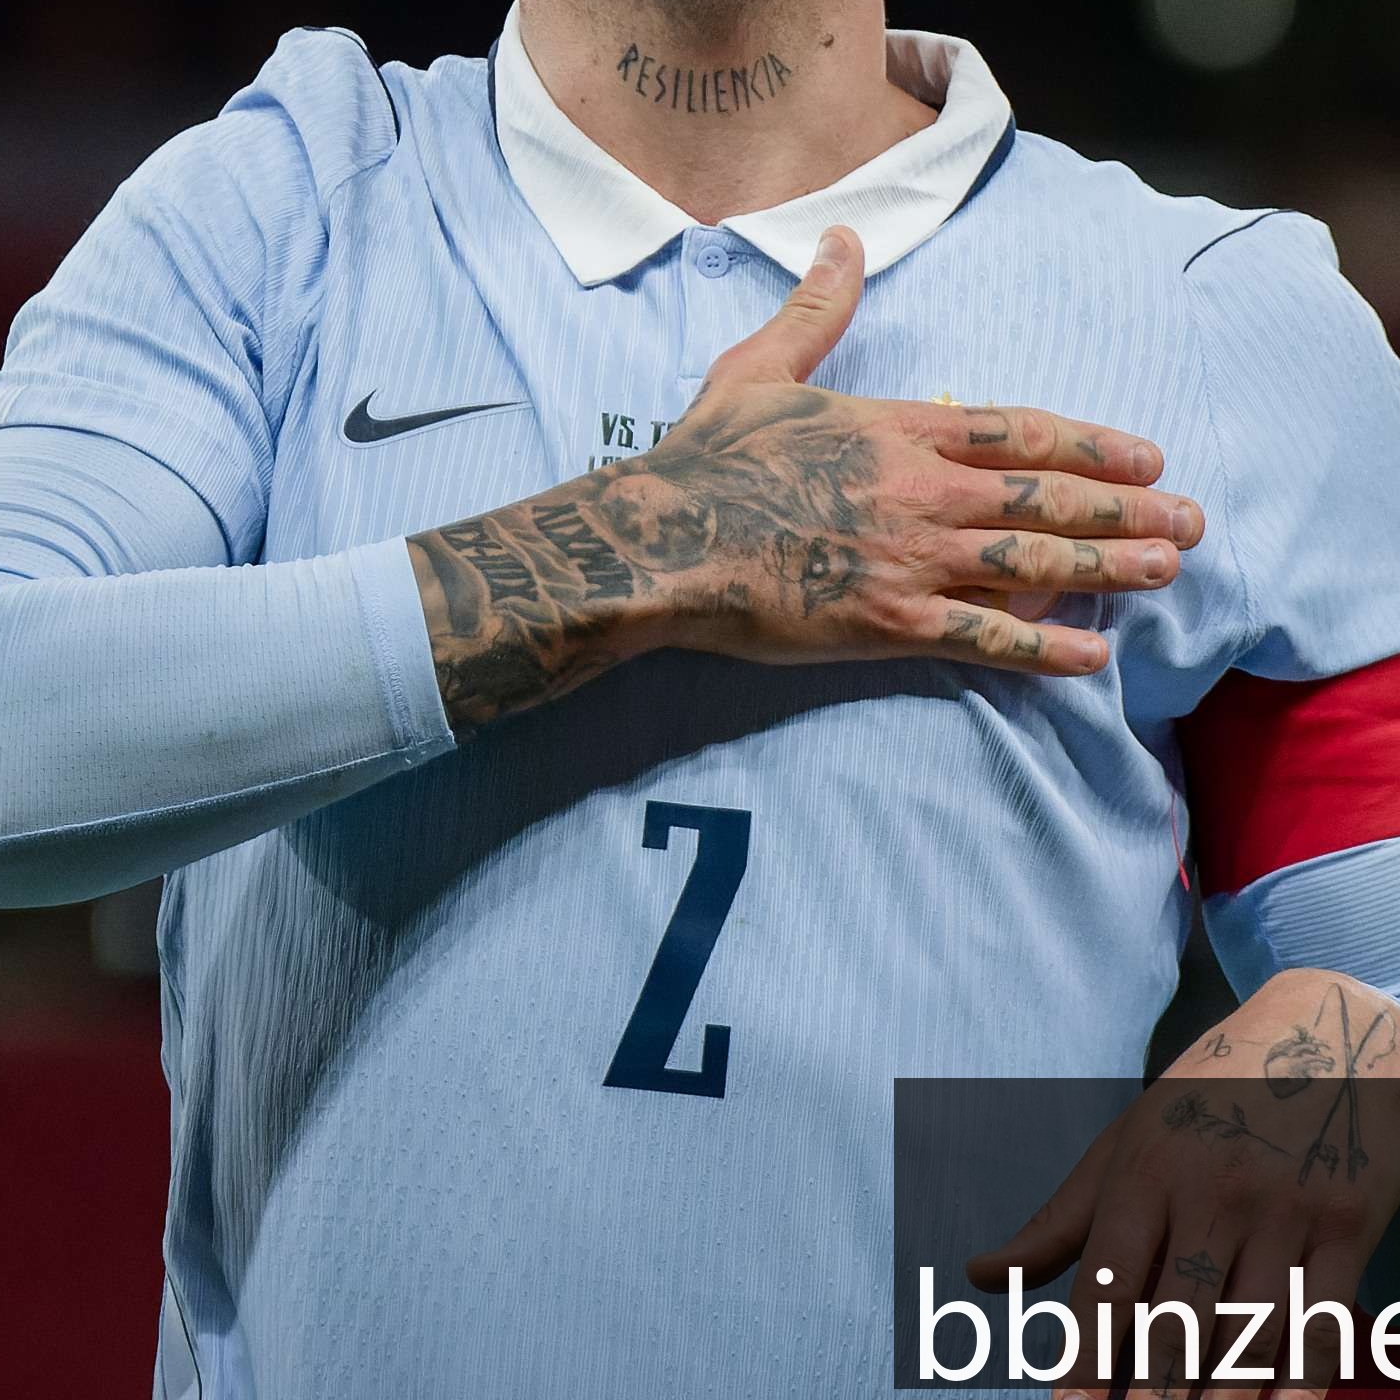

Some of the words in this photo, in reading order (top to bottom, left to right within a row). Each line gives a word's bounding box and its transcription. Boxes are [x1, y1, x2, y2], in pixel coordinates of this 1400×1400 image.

[617, 43, 792, 114] RESILIENCIA
[602, 412, 639, 450] VS.
[603, 800, 751, 1098] 2
